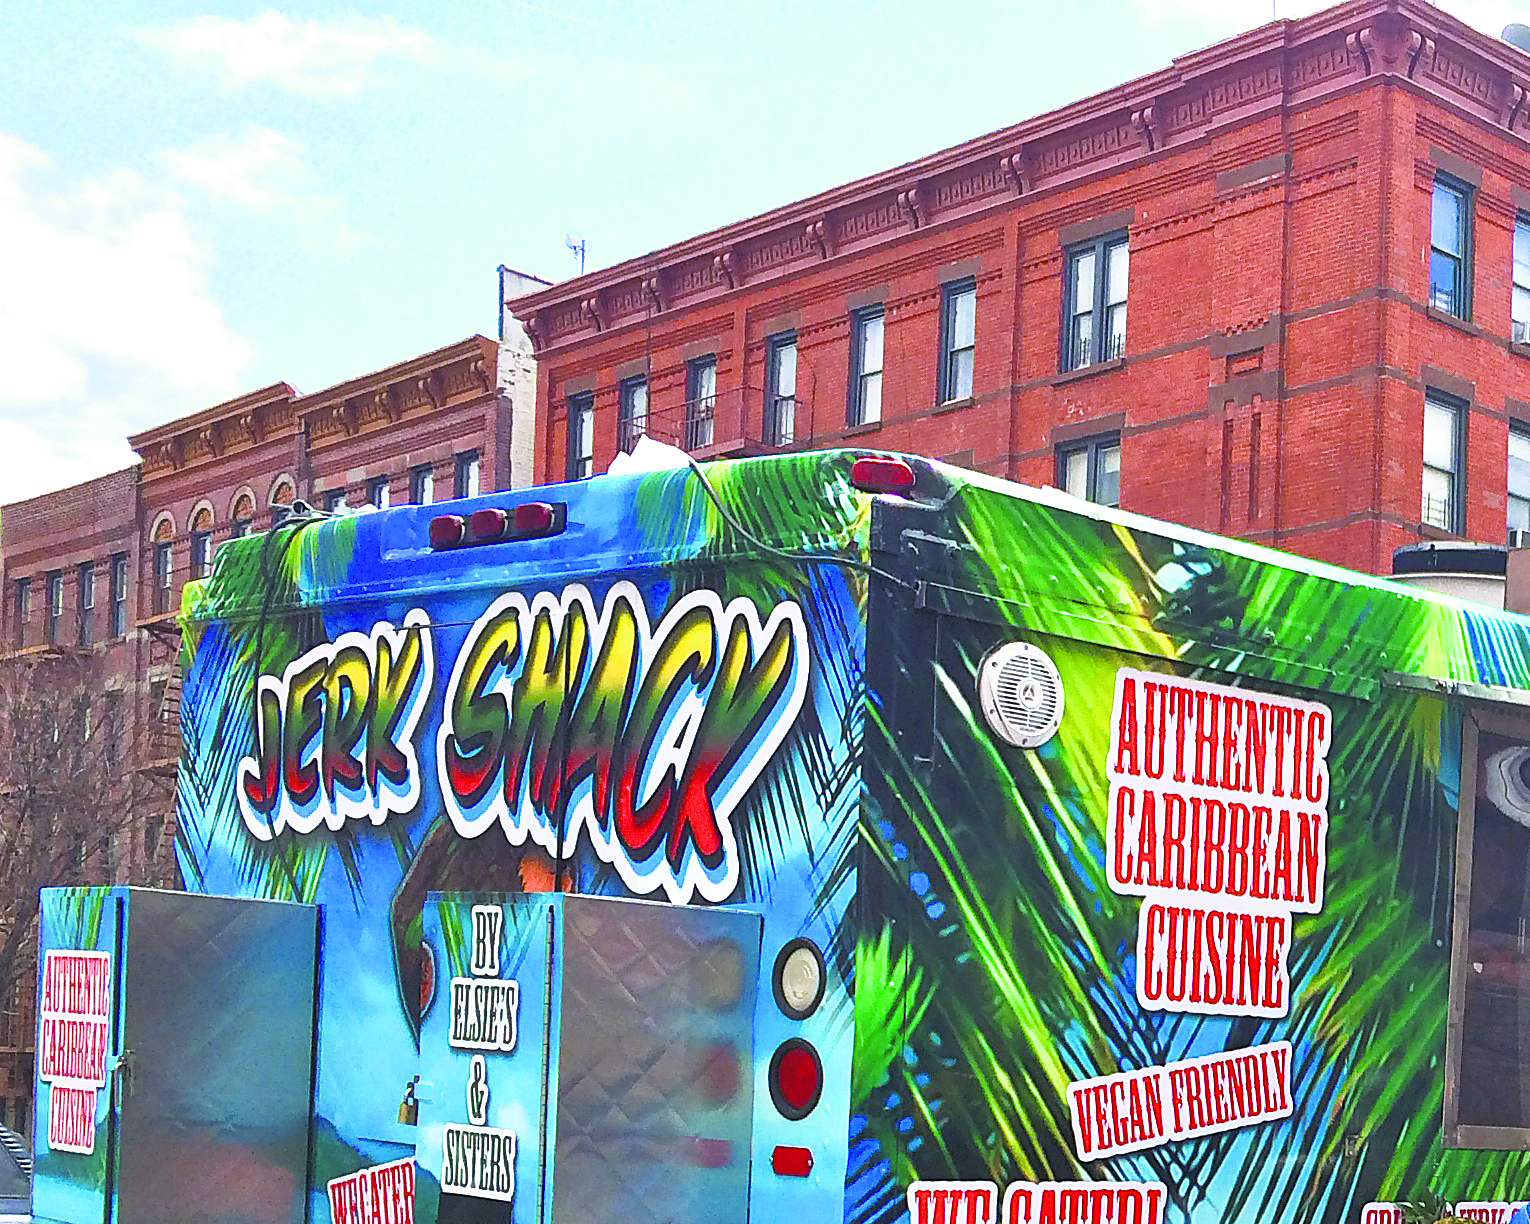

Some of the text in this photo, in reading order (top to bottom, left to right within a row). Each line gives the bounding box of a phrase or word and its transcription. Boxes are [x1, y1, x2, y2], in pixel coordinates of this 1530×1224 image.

[243, 595, 795, 880] JERK SHACK
[1115, 677, 1326, 803] AUTHENTIC
[1115, 786, 1321, 905] CARIBBEAN
[475, 911, 498, 970] BY
[1145, 904, 1285, 1009] CUISINE
[43, 956, 109, 1016] AUTHENTIC
[453, 984, 515, 1045] ELSIE'S
[42, 1018, 106, 1081] CARIBBEAN
[50, 1086, 94, 1148] CUISINE
[470, 1061, 484, 1119] &
[1074, 1049, 1289, 1153] VEGAN FRIENDLY
[445, 1129, 512, 1194] SISTERS
